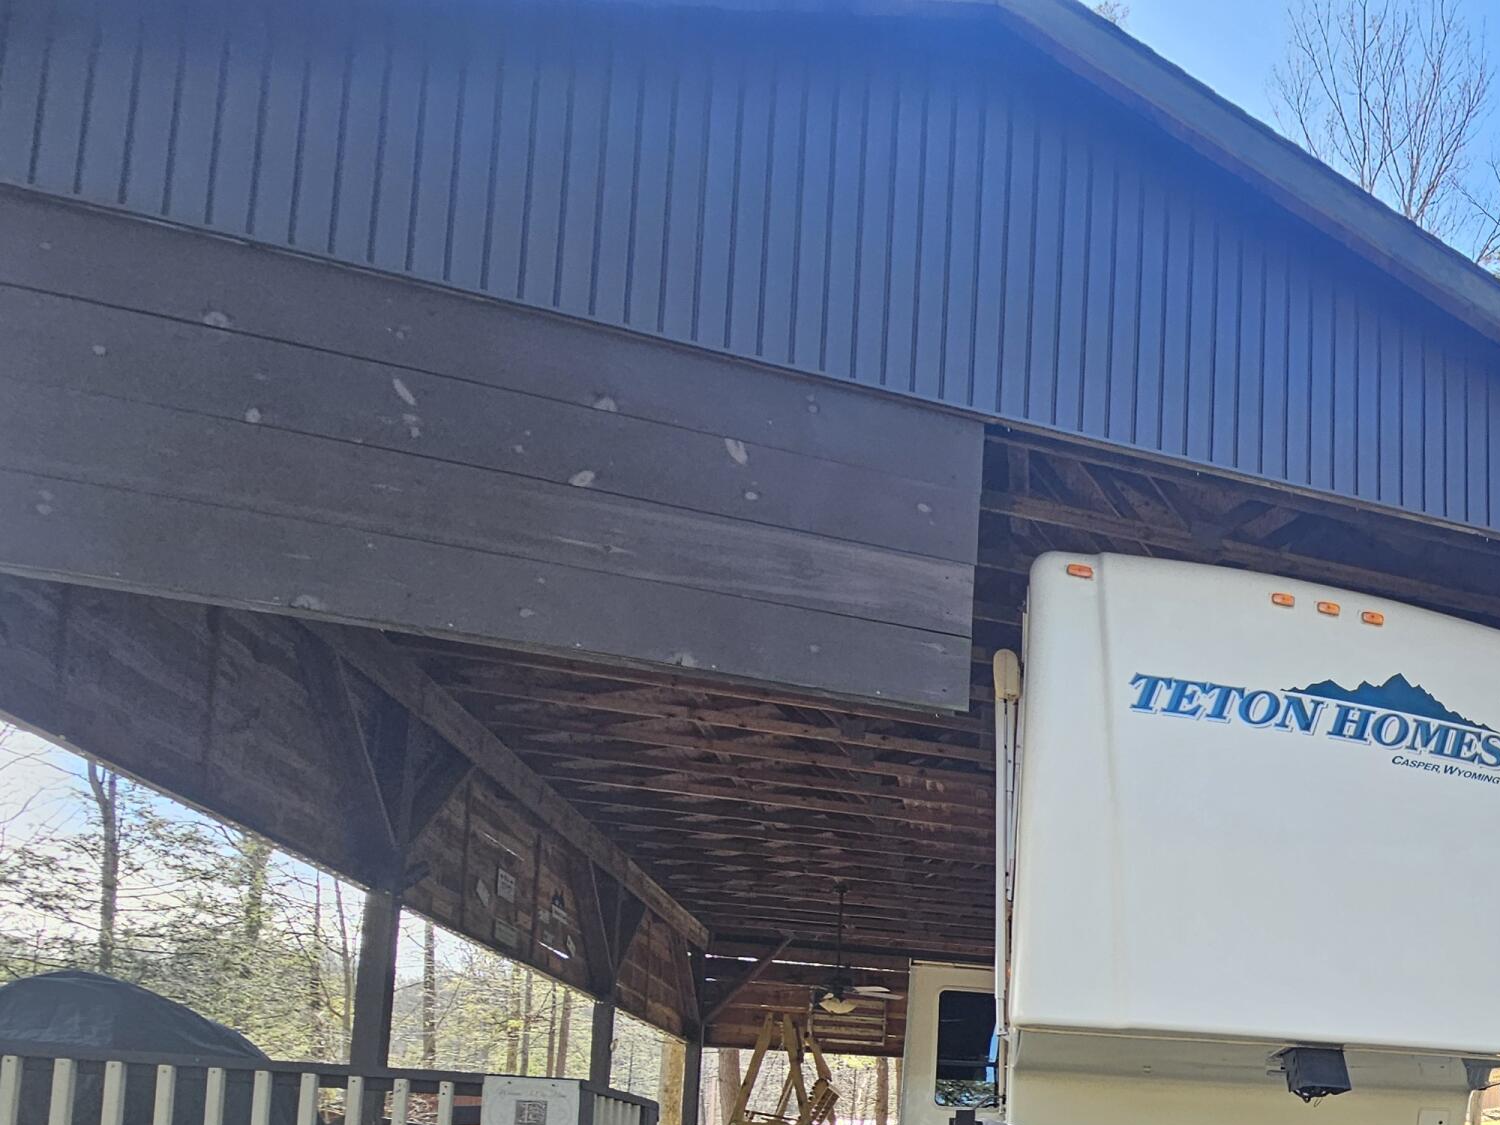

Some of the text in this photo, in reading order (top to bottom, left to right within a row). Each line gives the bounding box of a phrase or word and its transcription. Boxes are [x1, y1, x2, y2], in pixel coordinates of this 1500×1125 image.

[1129, 672, 1328, 736] TETON
[1391, 755, 1500, 785] CASPER, WYOMING
